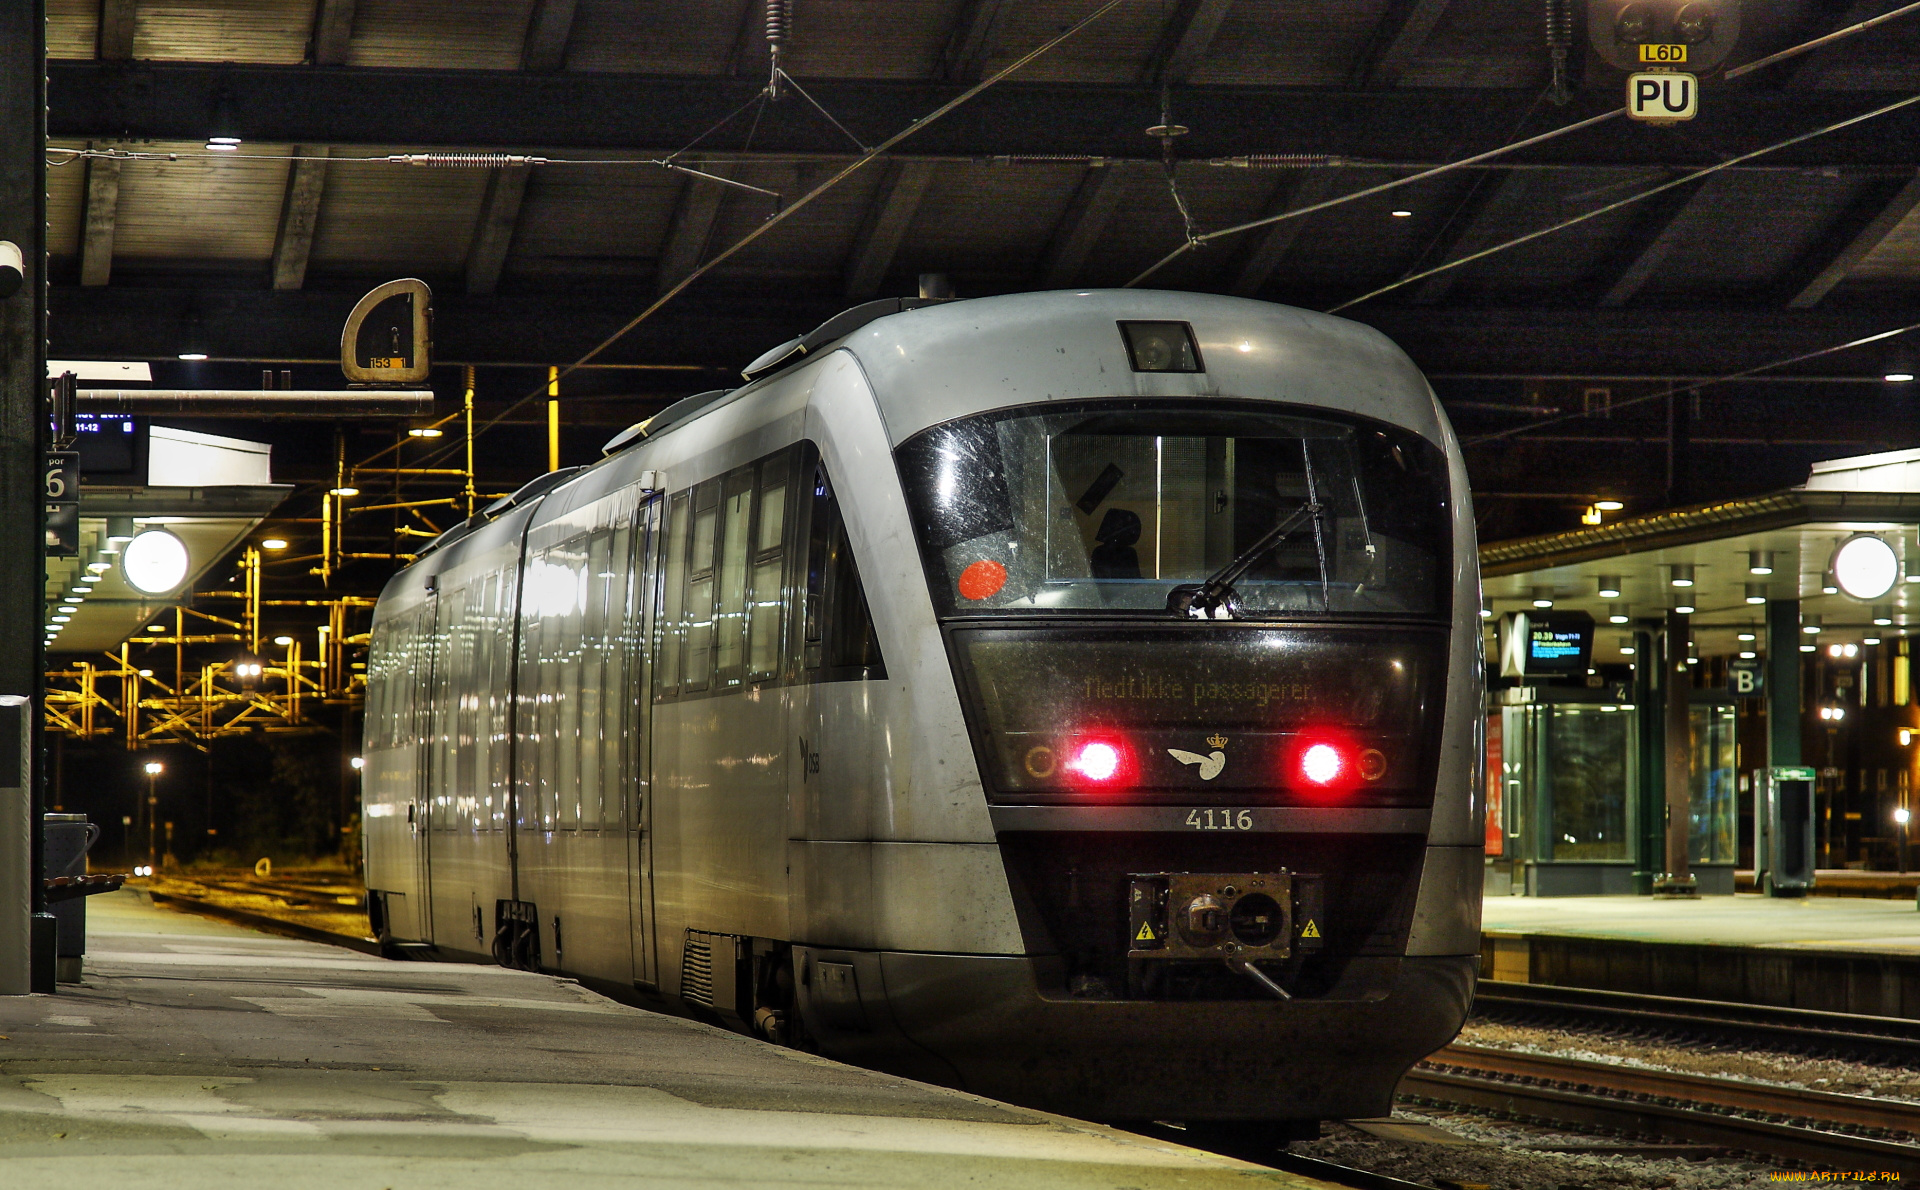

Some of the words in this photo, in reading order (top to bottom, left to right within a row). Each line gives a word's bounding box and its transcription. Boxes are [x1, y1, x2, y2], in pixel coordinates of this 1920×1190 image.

[1645, 45, 1683, 60] L6D
[1636, 79, 1689, 112] PU
[75, 423, 98, 432] 11-12
[46, 468, 65, 498] 6
[1737, 670, 1755, 693] B
[1616, 687, 1626, 700] 4
[1185, 808, 1253, 831] 4116
